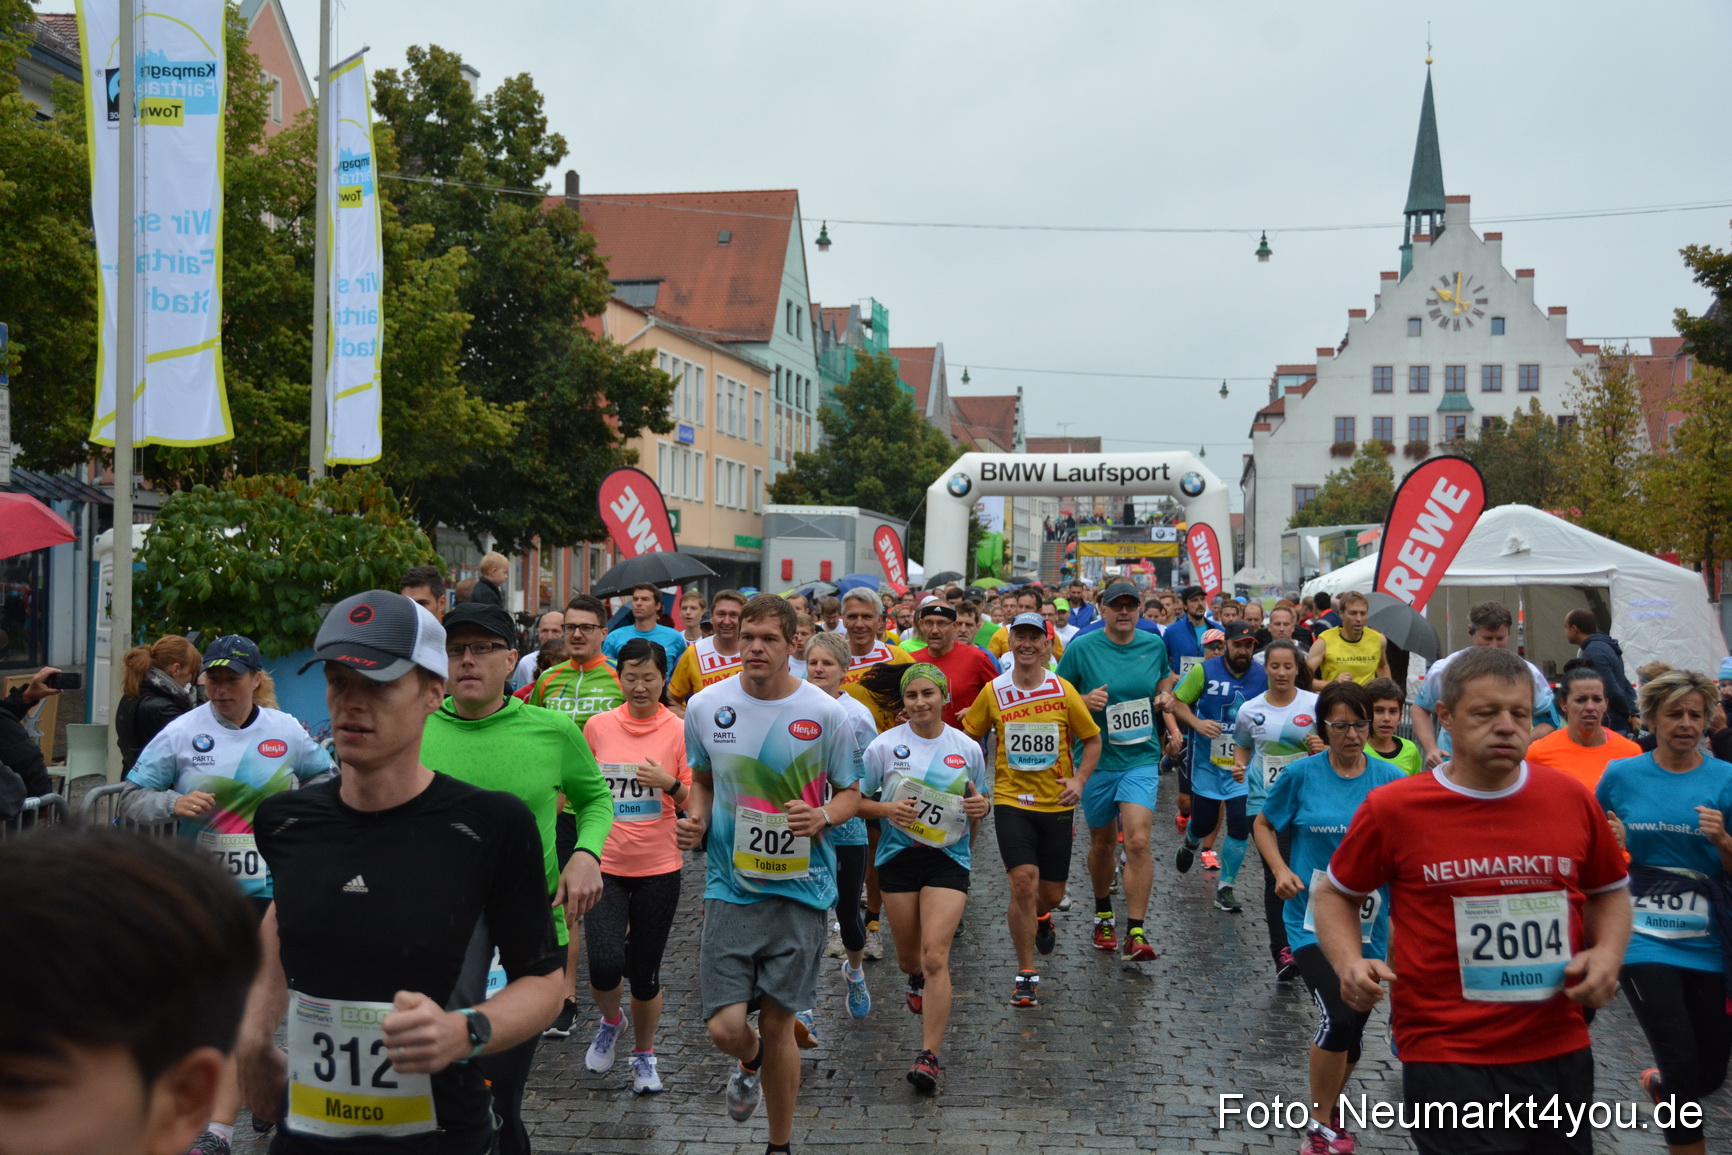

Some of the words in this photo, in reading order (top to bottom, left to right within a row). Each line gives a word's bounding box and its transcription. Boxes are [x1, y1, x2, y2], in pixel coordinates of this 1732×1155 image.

[981, 462, 1046, 482] BMW
[1053, 462, 1171, 486] Laufsport
[1384, 476, 1470, 606] REWE
[1117, 545, 1140, 555] ZIEL
[842, 673, 860, 685] AX
[1207, 680, 1230, 696] 21
[1001, 707, 1031, 723] MAX
[1034, 701, 1067, 714] BÖGL
[1112, 709, 1150, 730] 3066
[792, 723, 819, 735] Hervis
[262, 744, 285, 752] Hervis
[1010, 735, 1055, 752] 2688
[1018, 756, 1046, 764] Andreas
[619, 804, 641, 813] Chen
[1309, 824, 1347, 834] www.h
[749, 826, 795, 855] 202
[213, 850, 259, 876] 750
[754, 858, 787, 871] Tobias
[1422, 855, 1553, 883] NEUMARKT
[1507, 895, 1560, 911] BOCK
[1645, 915, 1687, 928] Antonia
[1470, 919, 1563, 960] 2604
[1500, 970, 1543, 986] Anton
[313, 1031, 398, 1089] 312
[326, 1097, 384, 1121] Marco
